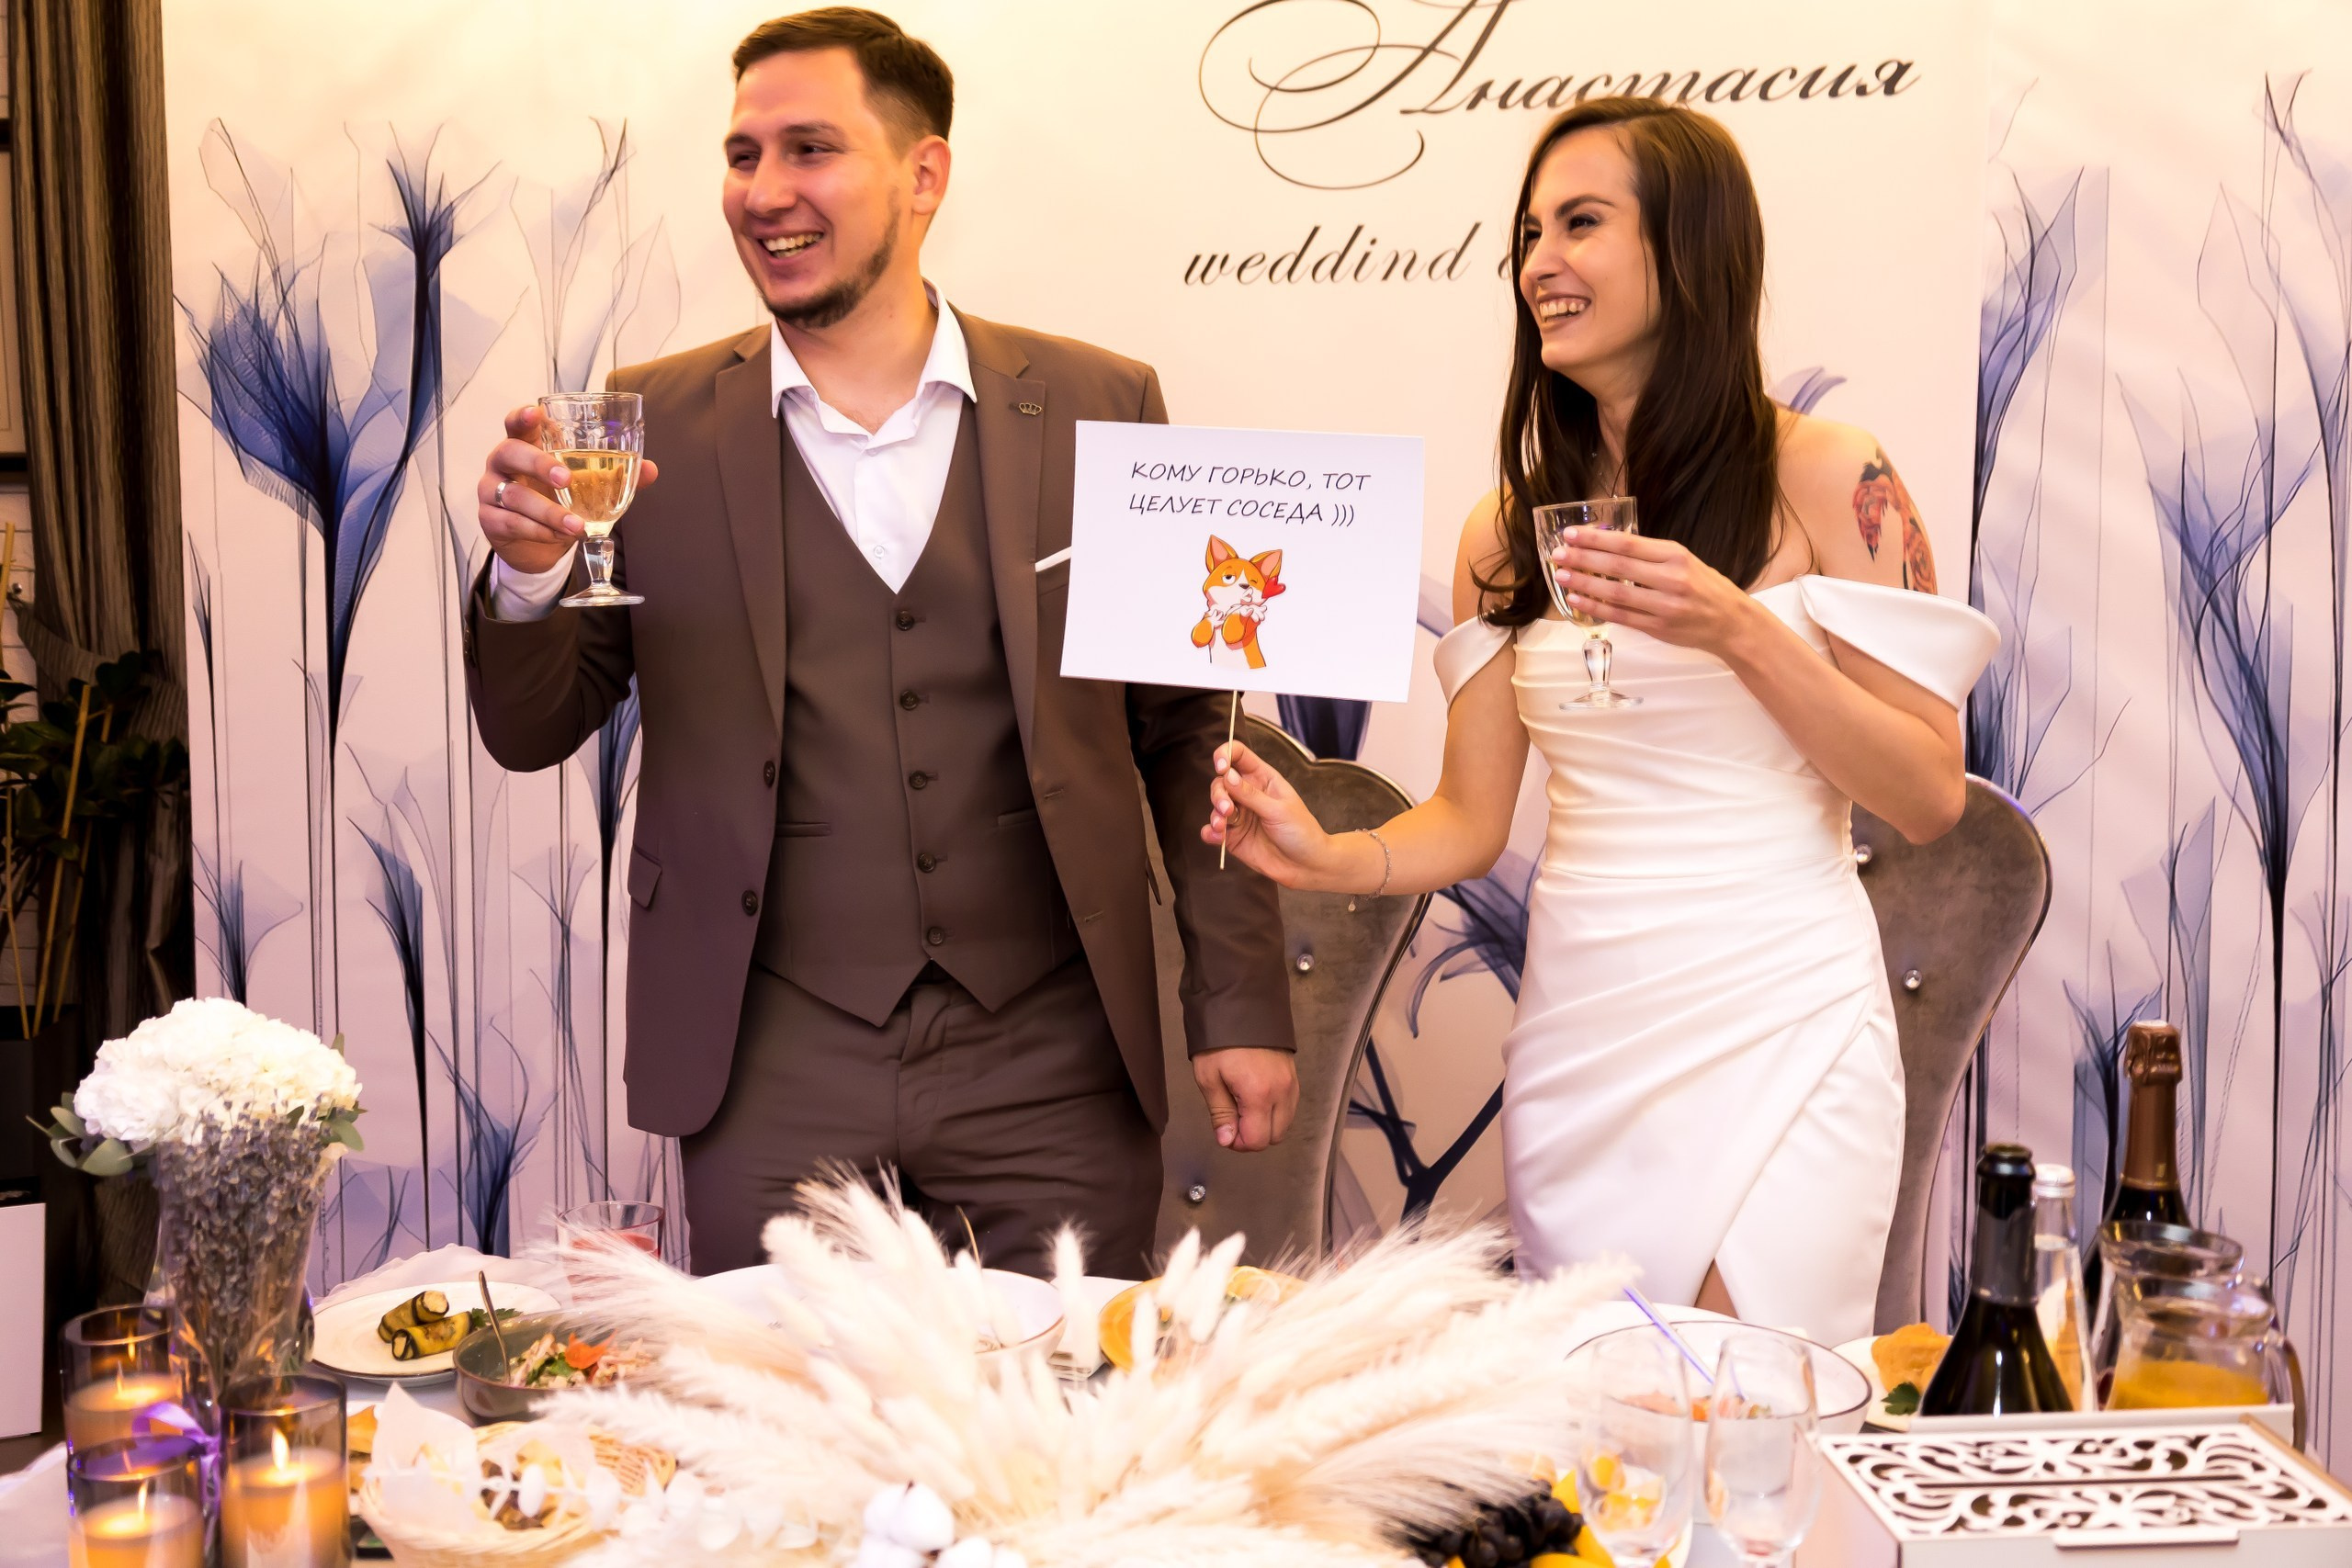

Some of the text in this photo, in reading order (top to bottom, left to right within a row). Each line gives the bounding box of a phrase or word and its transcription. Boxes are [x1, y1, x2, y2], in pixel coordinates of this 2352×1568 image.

[1183, 221, 1484, 287] weddind
[1131, 461, 1372, 491] КОМУ ГОРЬКО, ТОТ
[1129, 493, 1223, 515] ЦЕЛУЕТ
[1227, 499, 1323, 525] СОСЕДА
